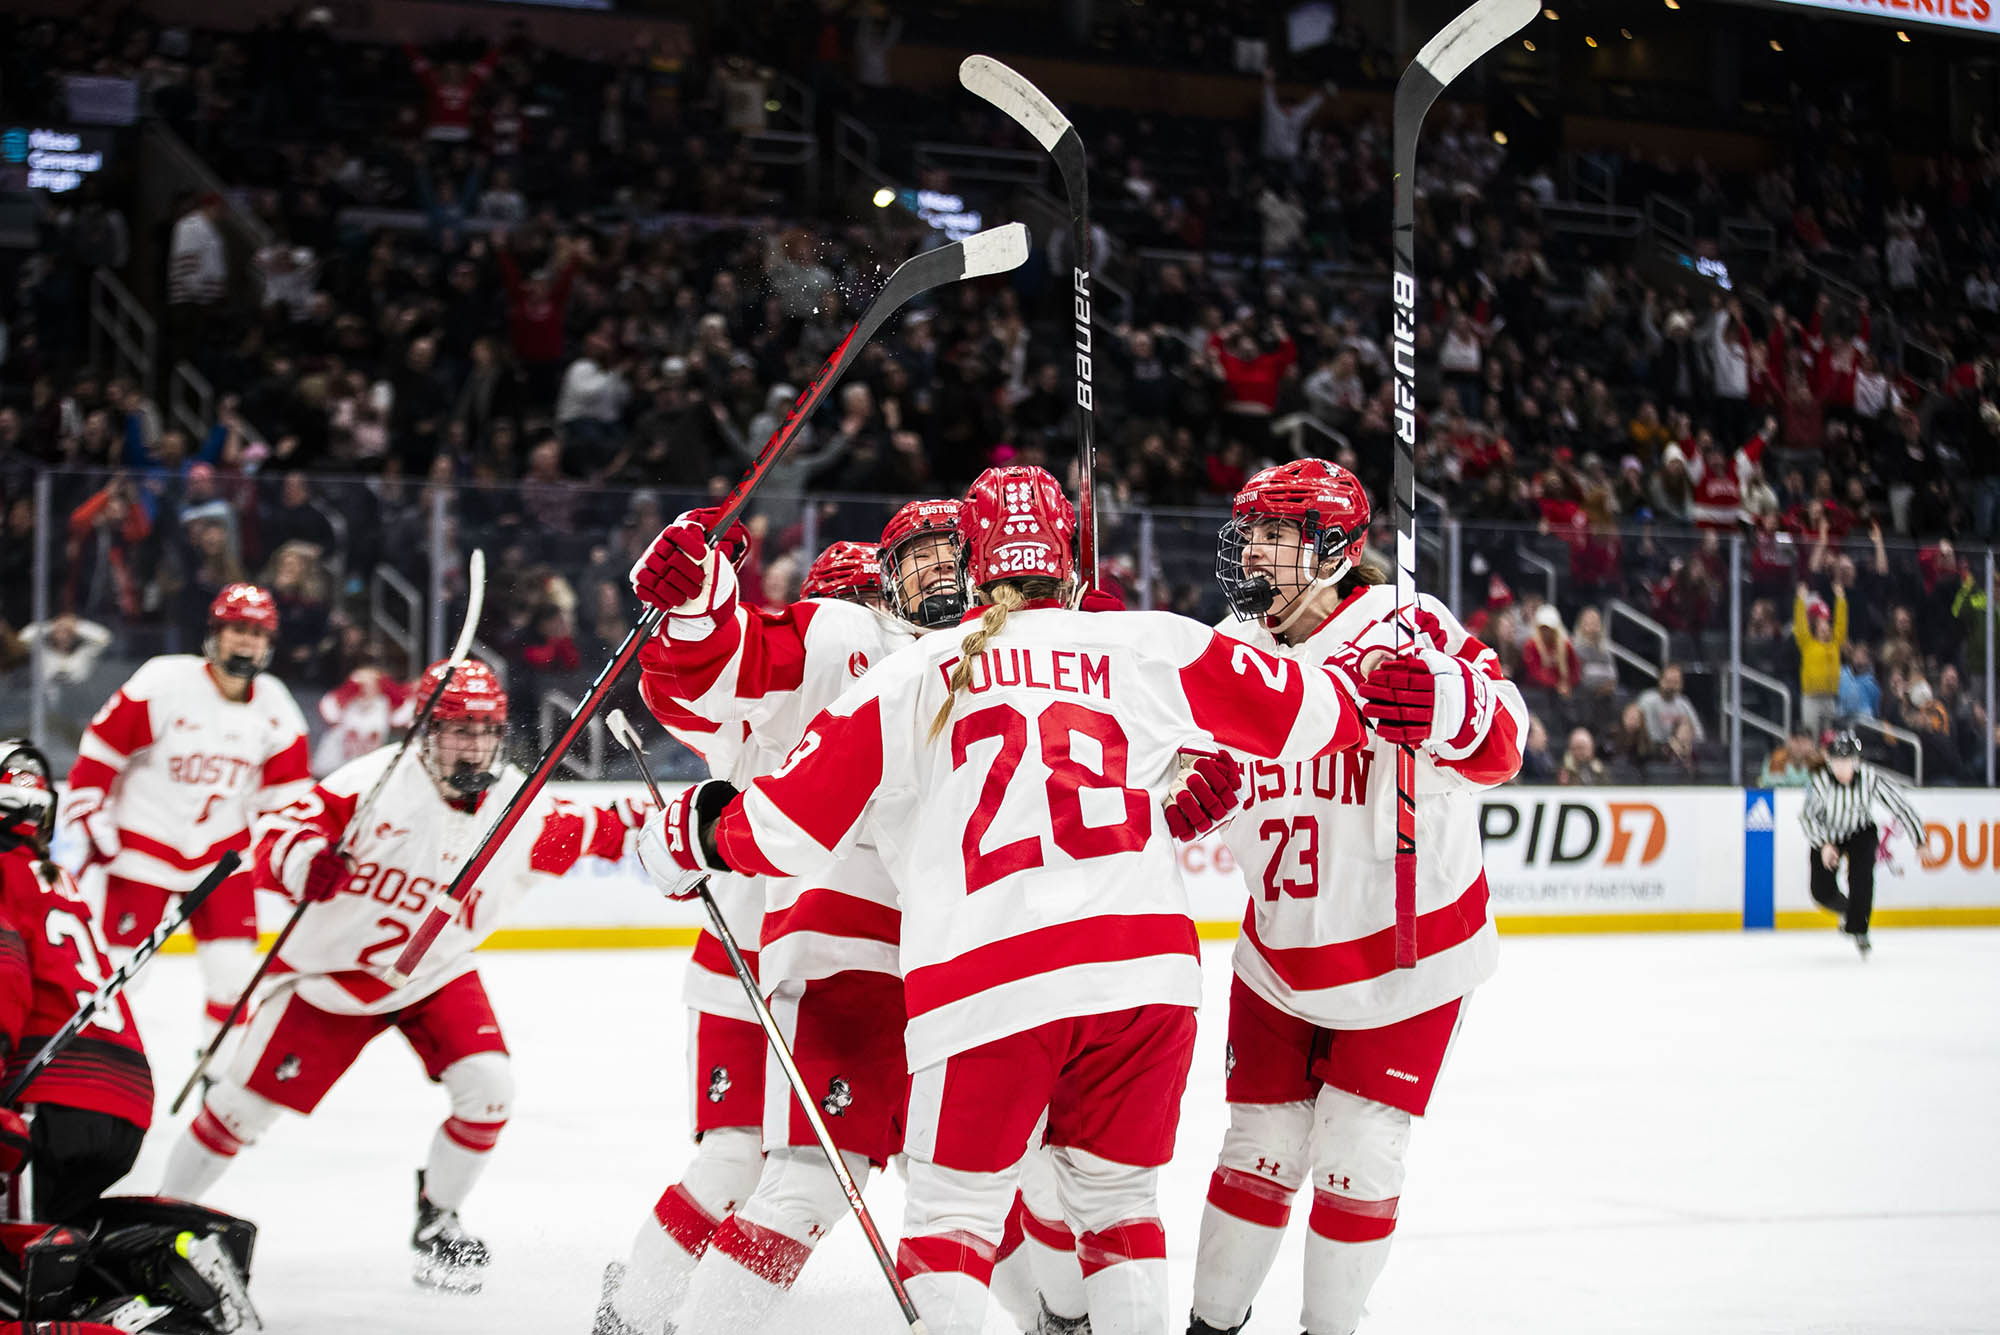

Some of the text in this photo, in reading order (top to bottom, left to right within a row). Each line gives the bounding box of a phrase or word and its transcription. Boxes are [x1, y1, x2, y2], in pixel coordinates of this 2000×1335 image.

[1074, 266, 1093, 412] BAUER
[1393, 271, 1415, 445] BAUER
[918, 506, 958, 516] BOSTON
[1236, 490, 1259, 506] BOSTON
[863, 563, 881, 574] BOS
[1010, 548, 1036, 571] 28
[168, 753, 250, 788] BOST
[951, 701, 1152, 896] 28
[1259, 815, 1319, 902] 23
[1479, 803, 1667, 865] PID7
[343, 862, 482, 931] BOSN
[355, 917, 411, 966] 2
